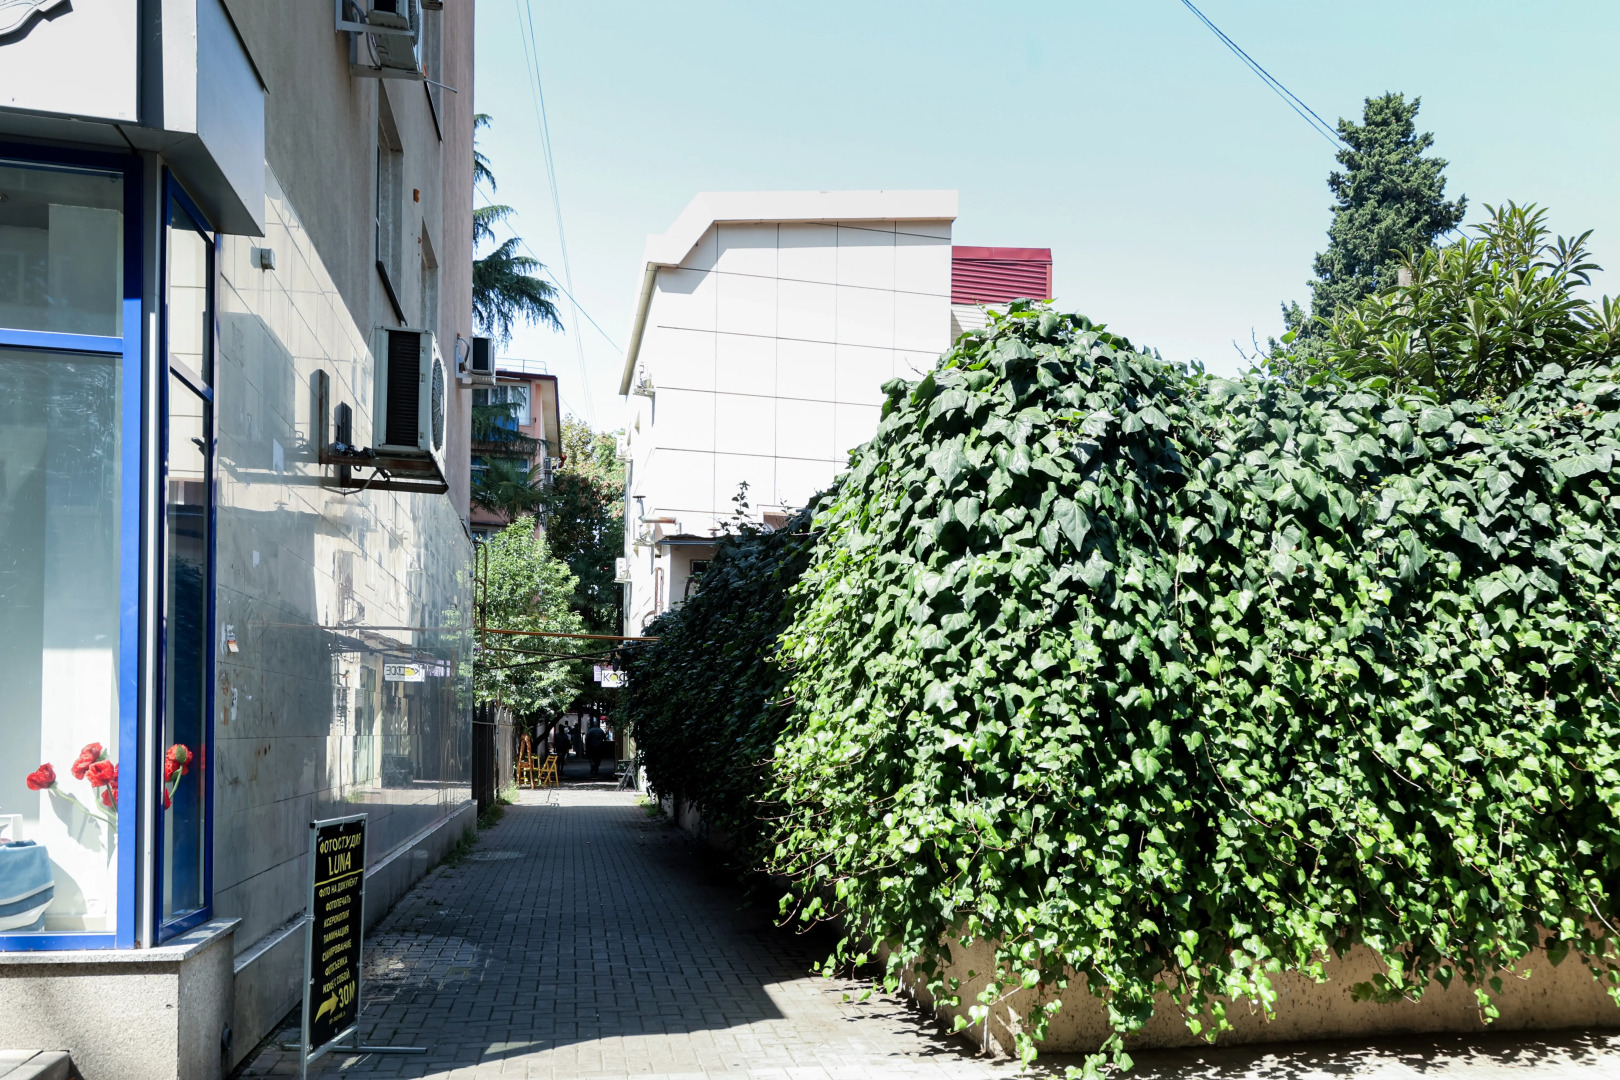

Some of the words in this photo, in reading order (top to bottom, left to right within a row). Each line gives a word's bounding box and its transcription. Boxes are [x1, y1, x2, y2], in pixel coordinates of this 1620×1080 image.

[603, 672, 627, 682] КОФ
[320, 833, 361, 854] ФОТОСТУДИЯ
[328, 852, 351, 876] LUNA
[319, 886, 331, 898] ФОТО
[331, 884, 337, 894] НА
[337, 877, 358, 893] ДОКУМЕНТ
[325, 895, 351, 911] ФОТОПЕЧАТЬ
[324, 910, 349, 928] КСЕРОКОПИЯ
[324, 925, 349, 944] ЛАМИНАЦИЯ
[322, 939, 351, 962] СКАНИРОВАНИЕ
[337, 968, 350, 985] СОБОЙ
